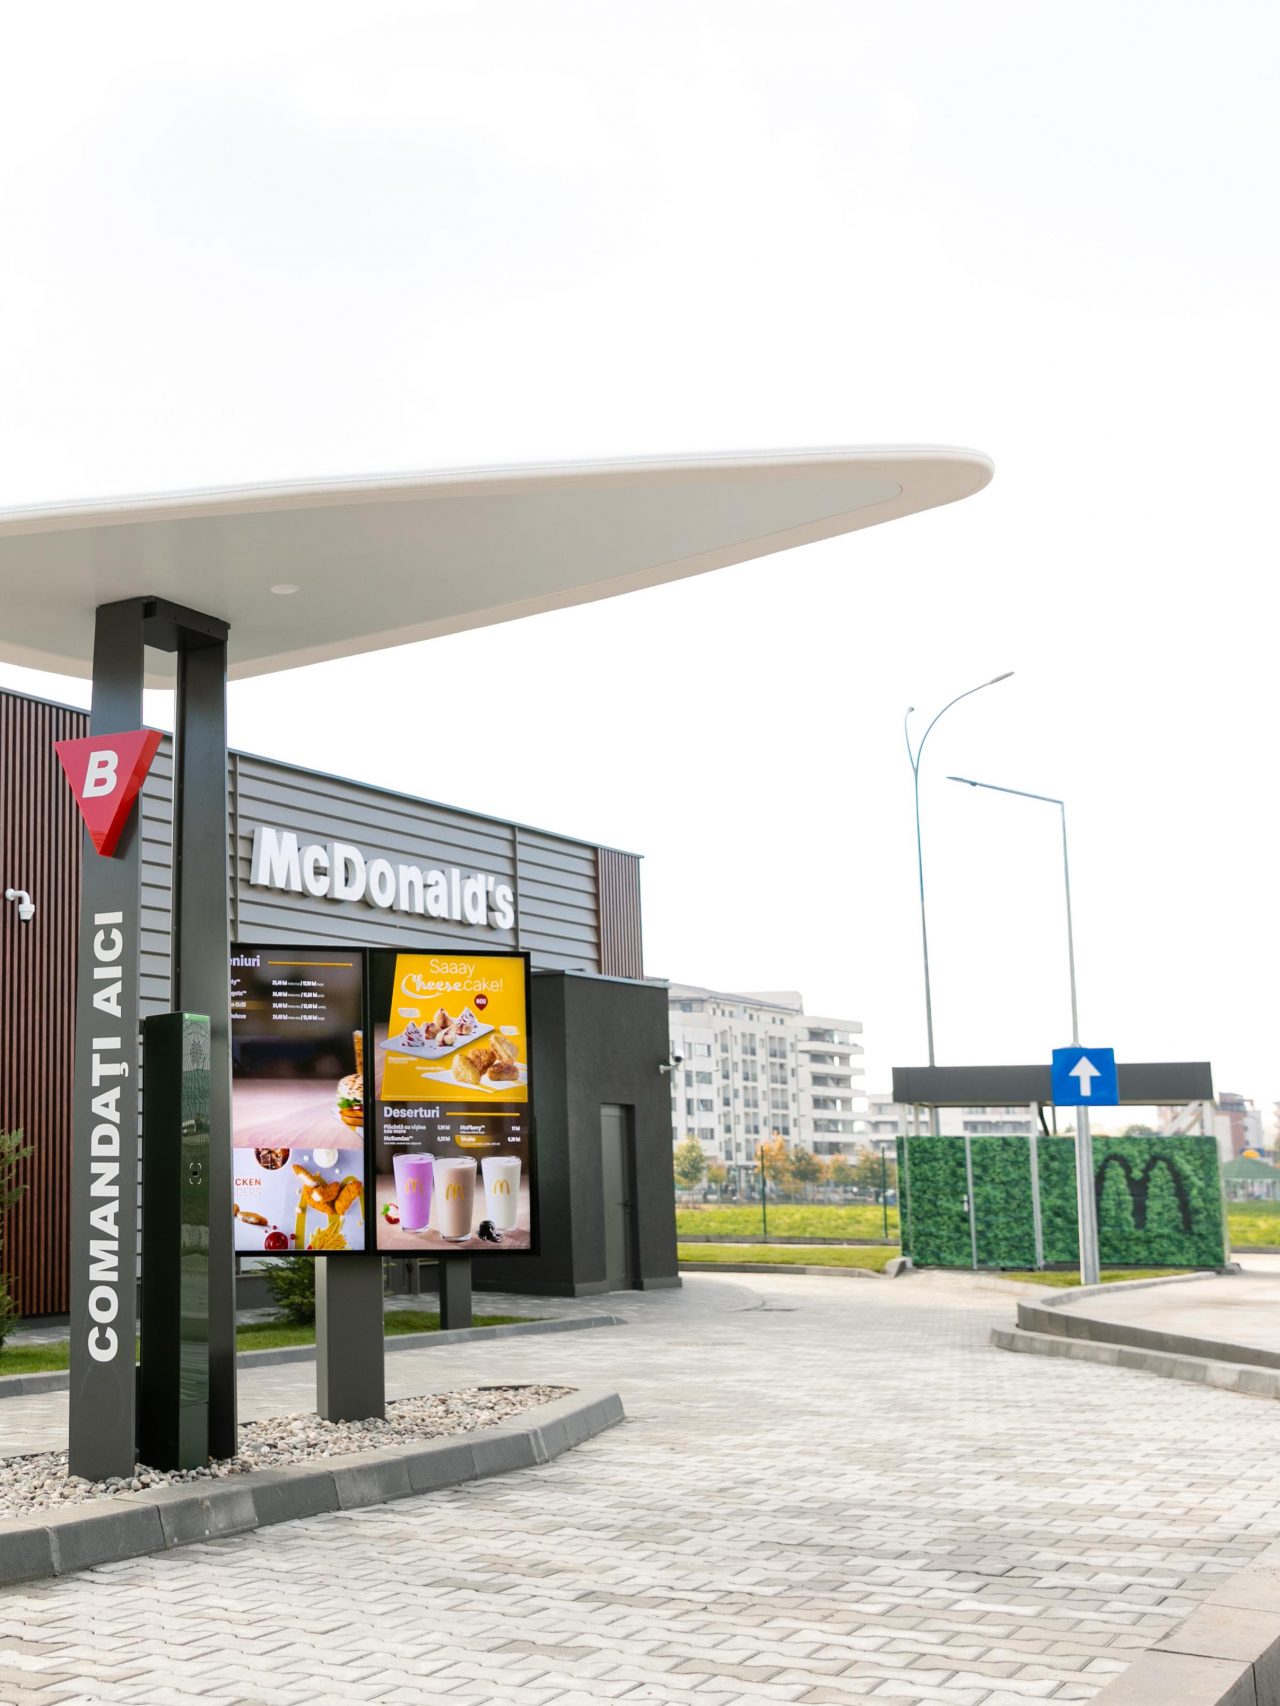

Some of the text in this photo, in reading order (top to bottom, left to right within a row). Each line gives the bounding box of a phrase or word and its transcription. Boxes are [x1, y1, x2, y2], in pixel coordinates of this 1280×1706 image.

[82, 749, 119, 798] B
[250, 826, 516, 930] McDonald's
[93, 911, 124, 1018] AICI
[429, 958, 476, 976] Saaay
[383, 1106, 440, 1119] Deserturi
[235, 1177, 262, 1186] CKEN
